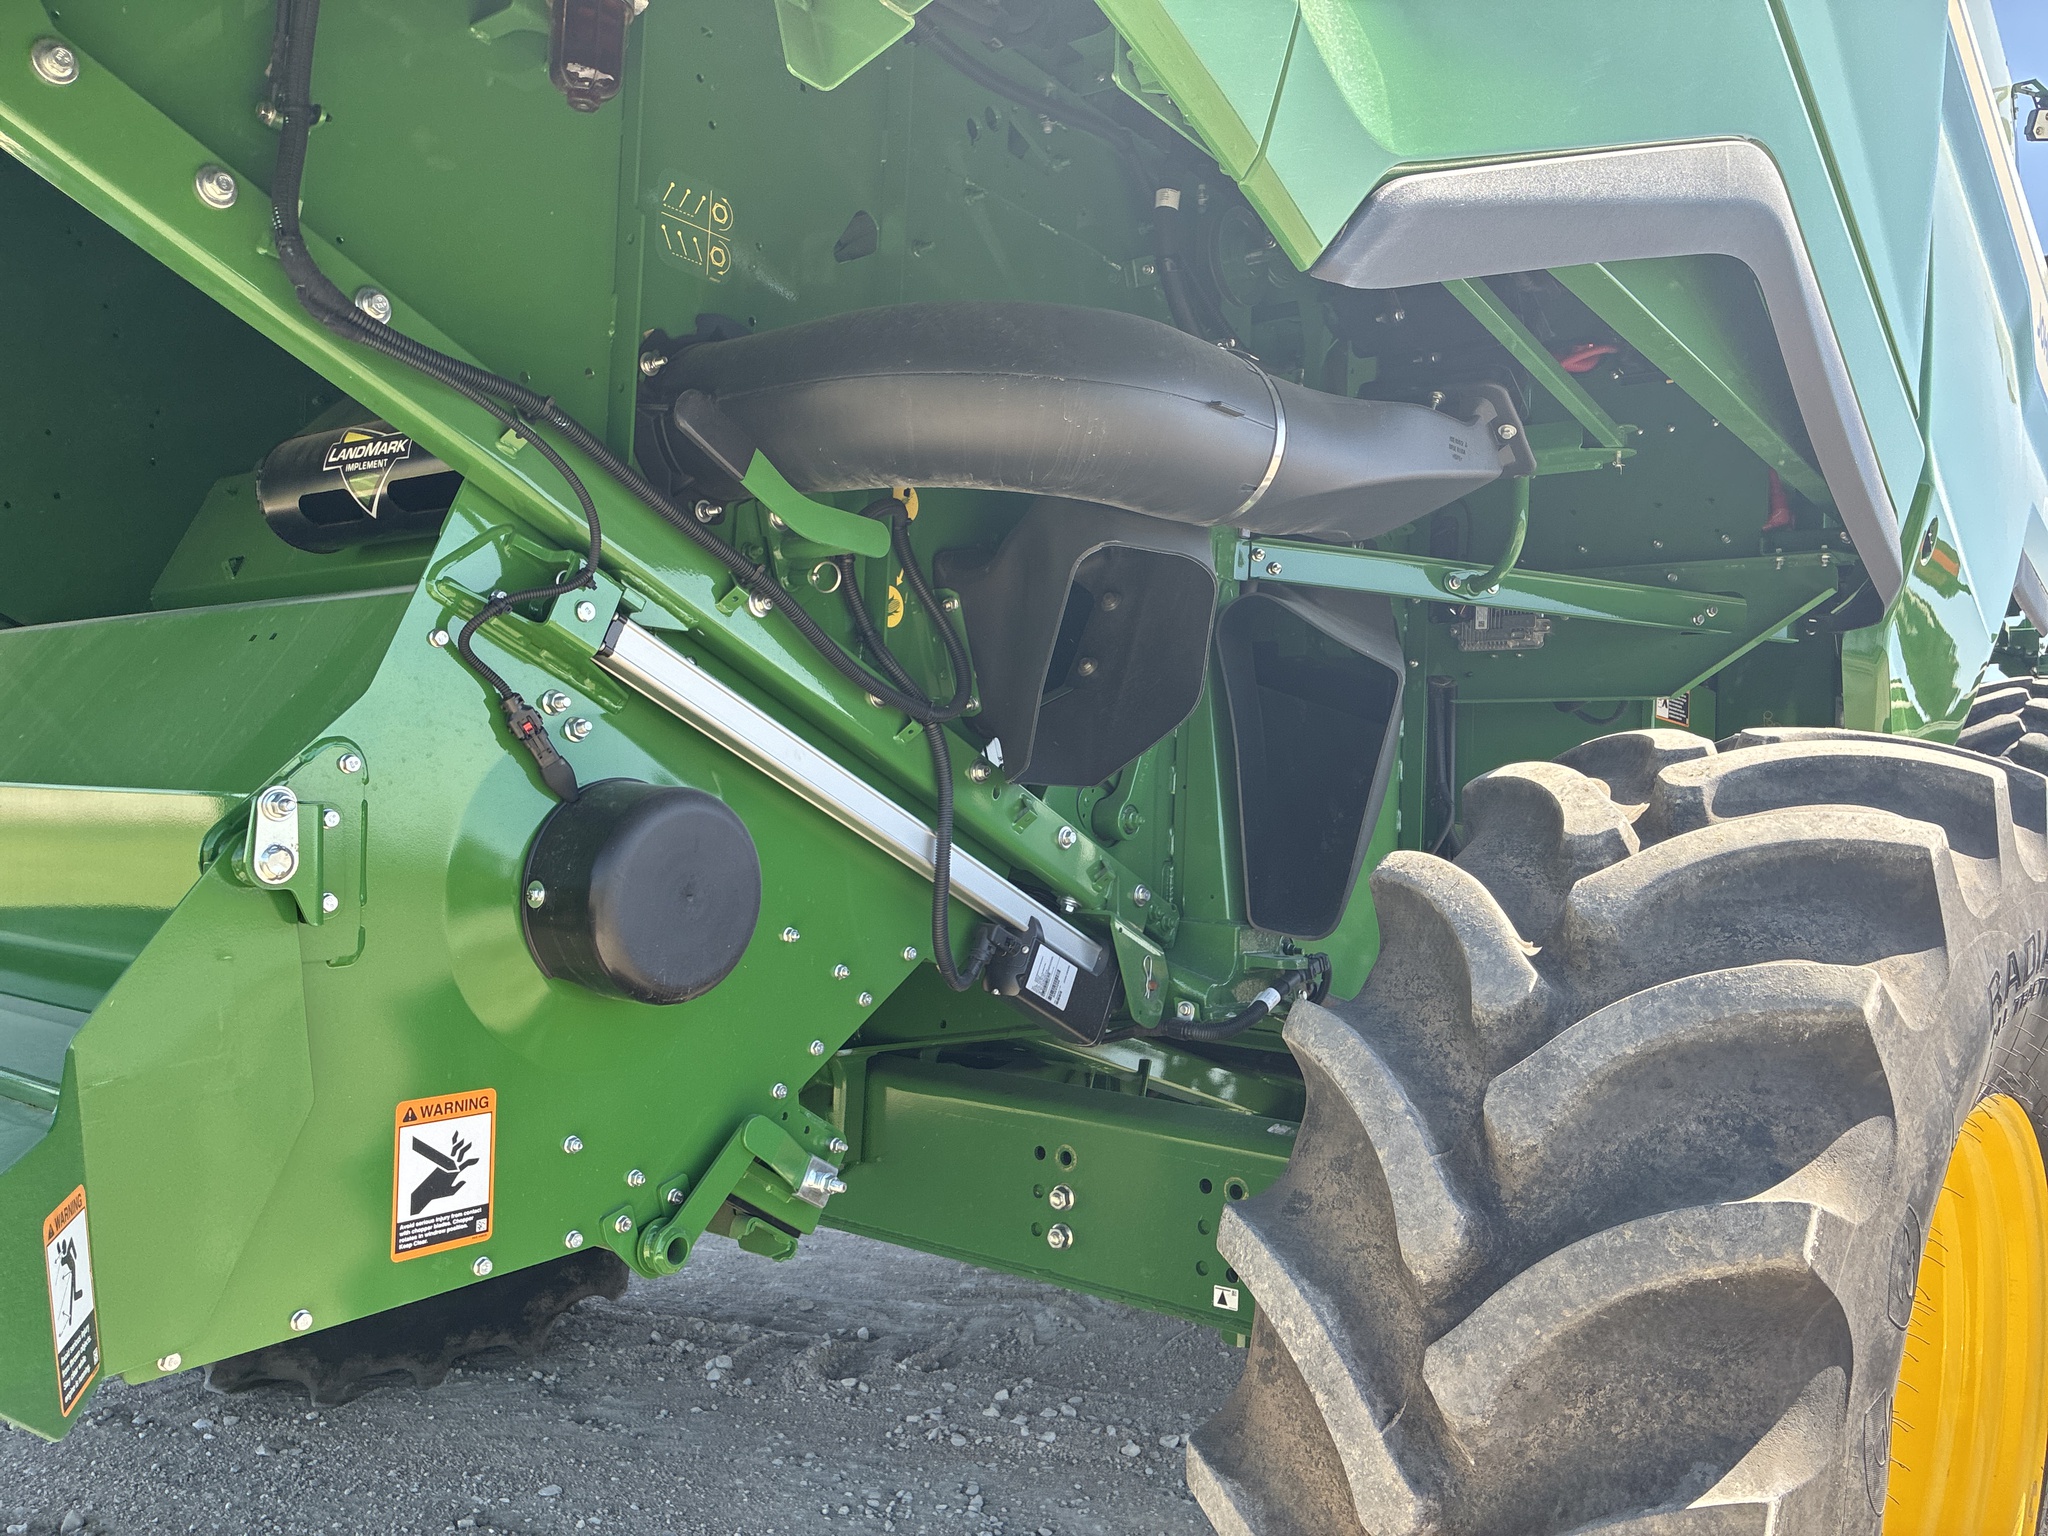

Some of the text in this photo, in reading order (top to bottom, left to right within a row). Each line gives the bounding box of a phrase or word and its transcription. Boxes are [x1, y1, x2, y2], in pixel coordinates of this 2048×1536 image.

[328, 438, 409, 462] LANDMARK
[345, 458, 388, 472] IMPLEMENT
[420, 1096, 489, 1118] WARNING
[54, 1193, 82, 1231] WARNING
[400, 1222, 415, 1230] Avoid
[416, 1219, 434, 1227] serious
[436, 1215, 450, 1223] injury
[464, 1208, 482, 1216] contact
[399, 1229, 411, 1237] with
[399, 1241, 413, 1250] Keep
